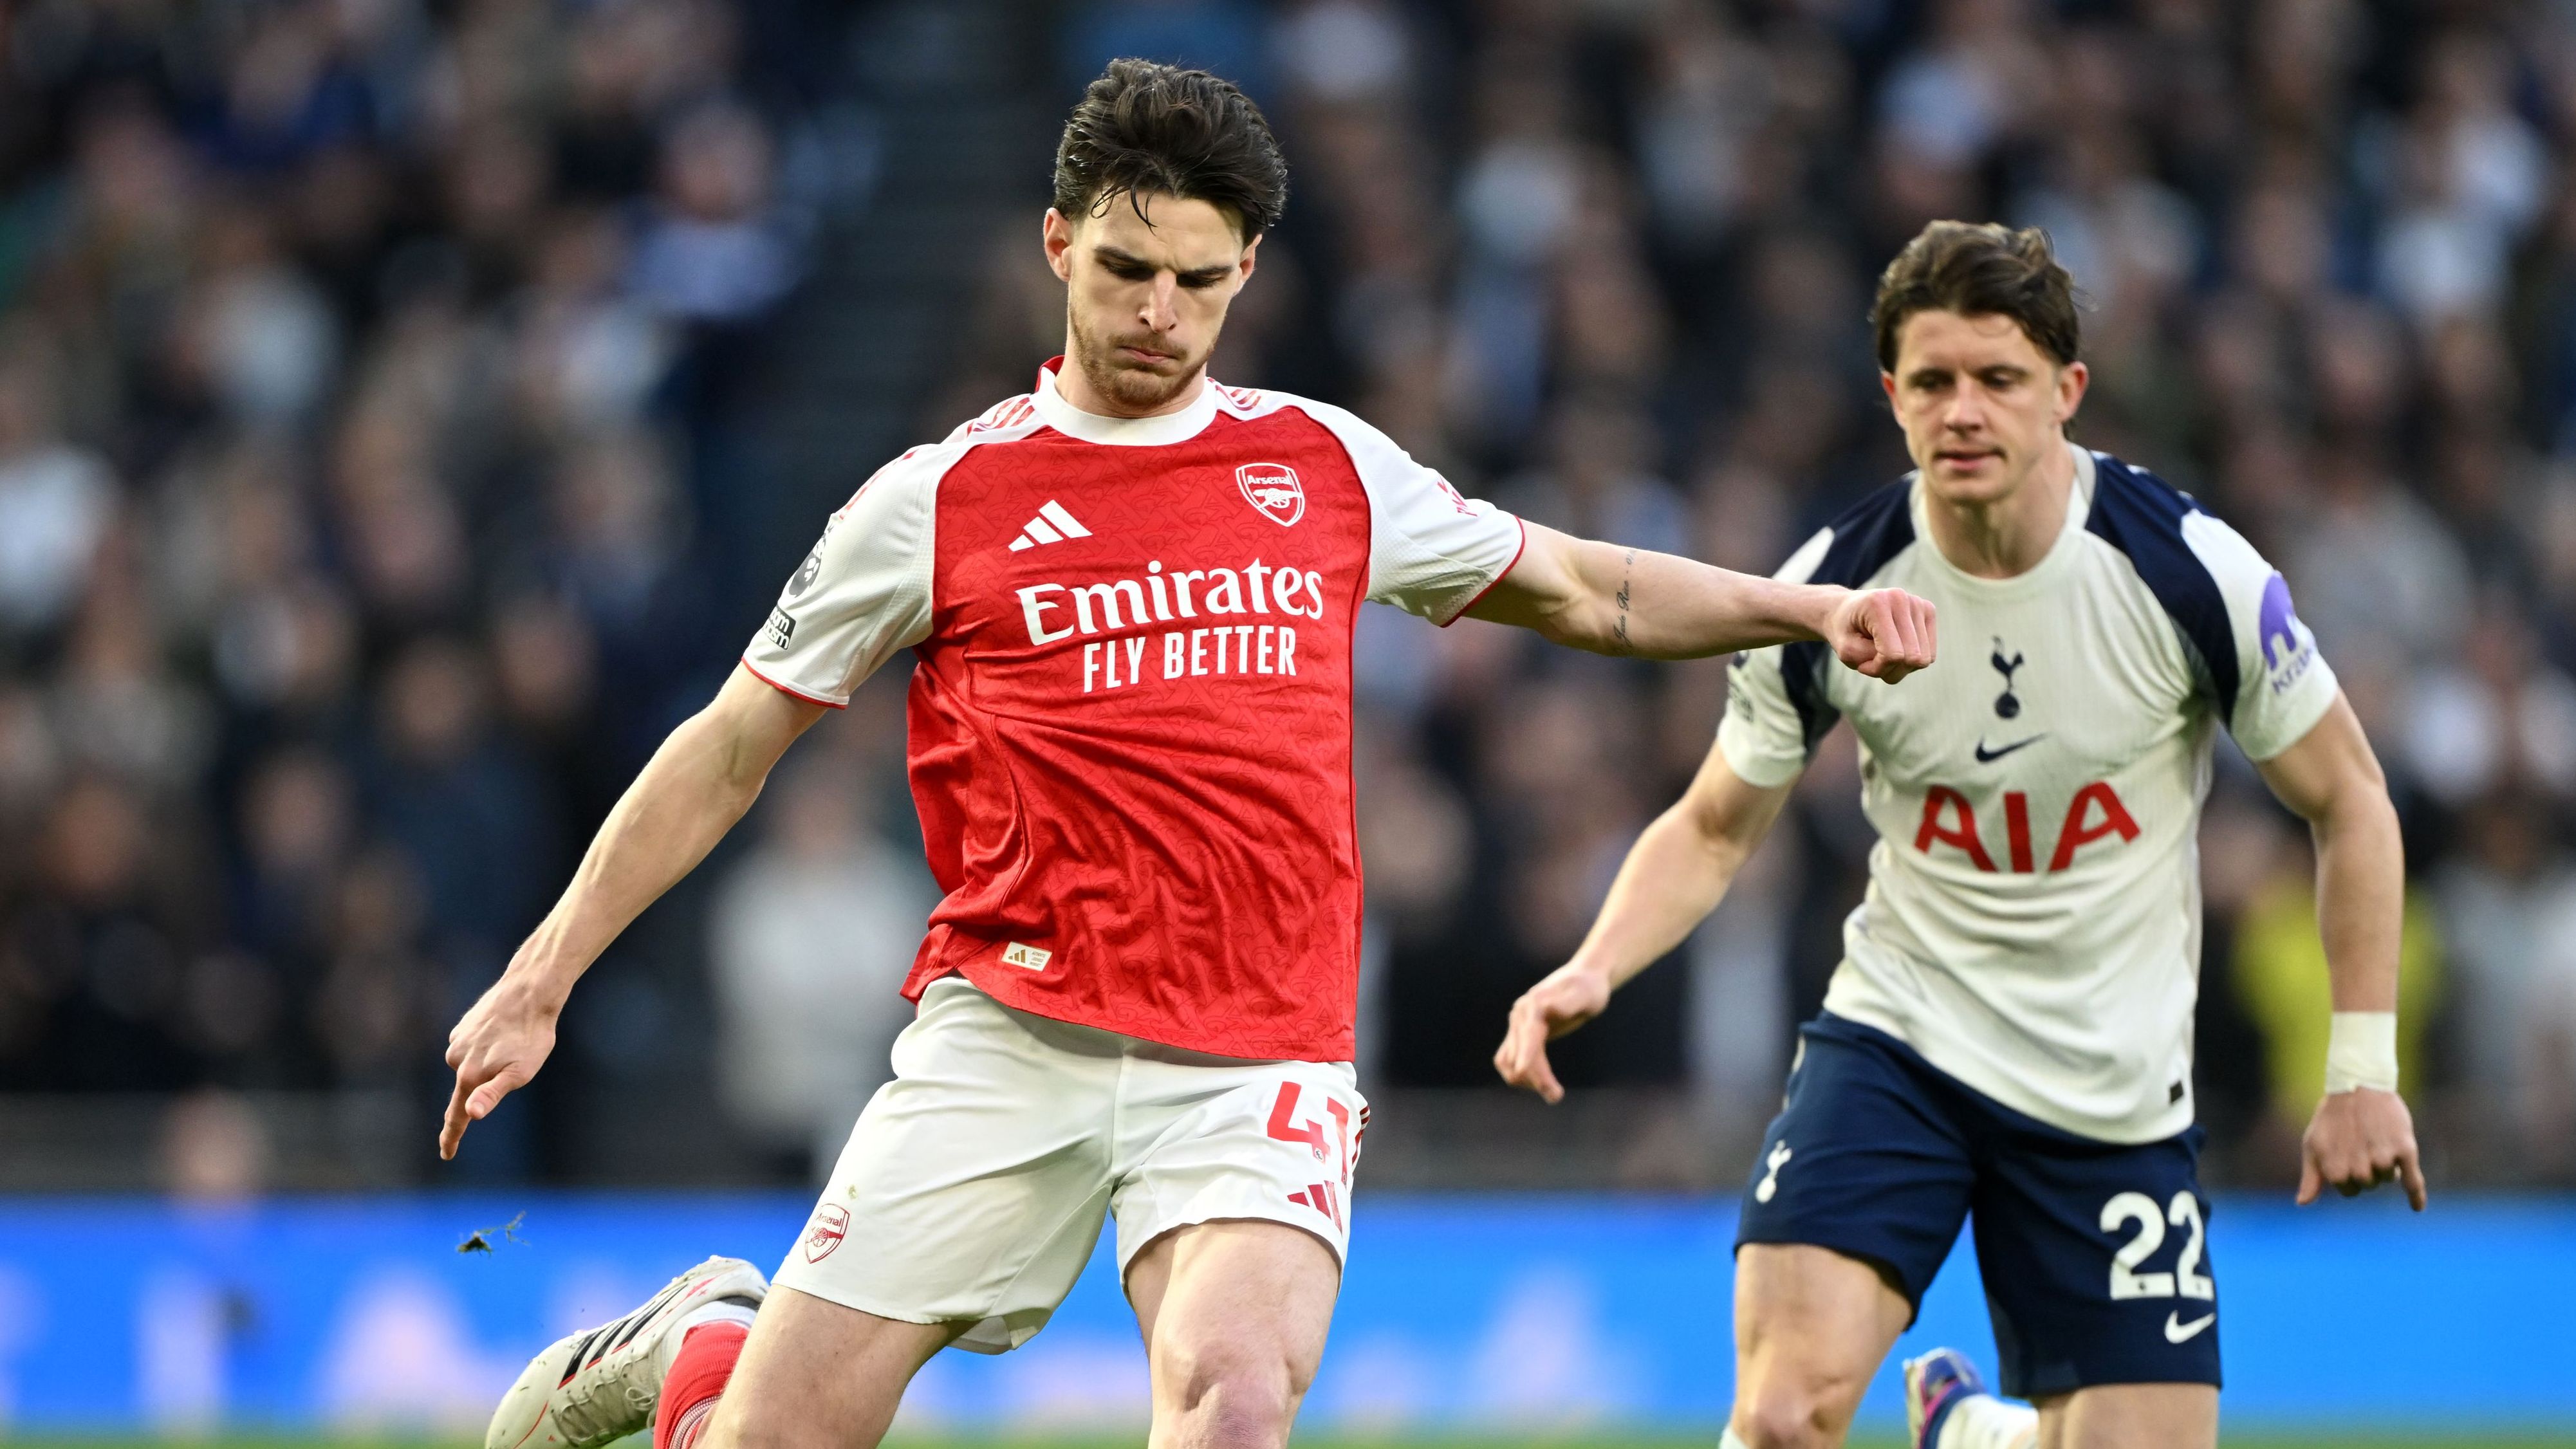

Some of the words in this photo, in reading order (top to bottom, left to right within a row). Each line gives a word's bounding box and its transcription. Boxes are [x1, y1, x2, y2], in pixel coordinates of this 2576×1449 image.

[1247, 475, 1293, 486] Arsenal
[1014, 557, 1323, 646] Emirates
[1083, 636, 1147, 693] FLY
[1163, 625, 1297, 680] BETTER
[1913, 781, 2142, 874] AIA
[1266, 1081, 1349, 1192] 41
[815, 1212, 843, 1228] Arsenal
[2099, 1190, 2214, 1301] 22
